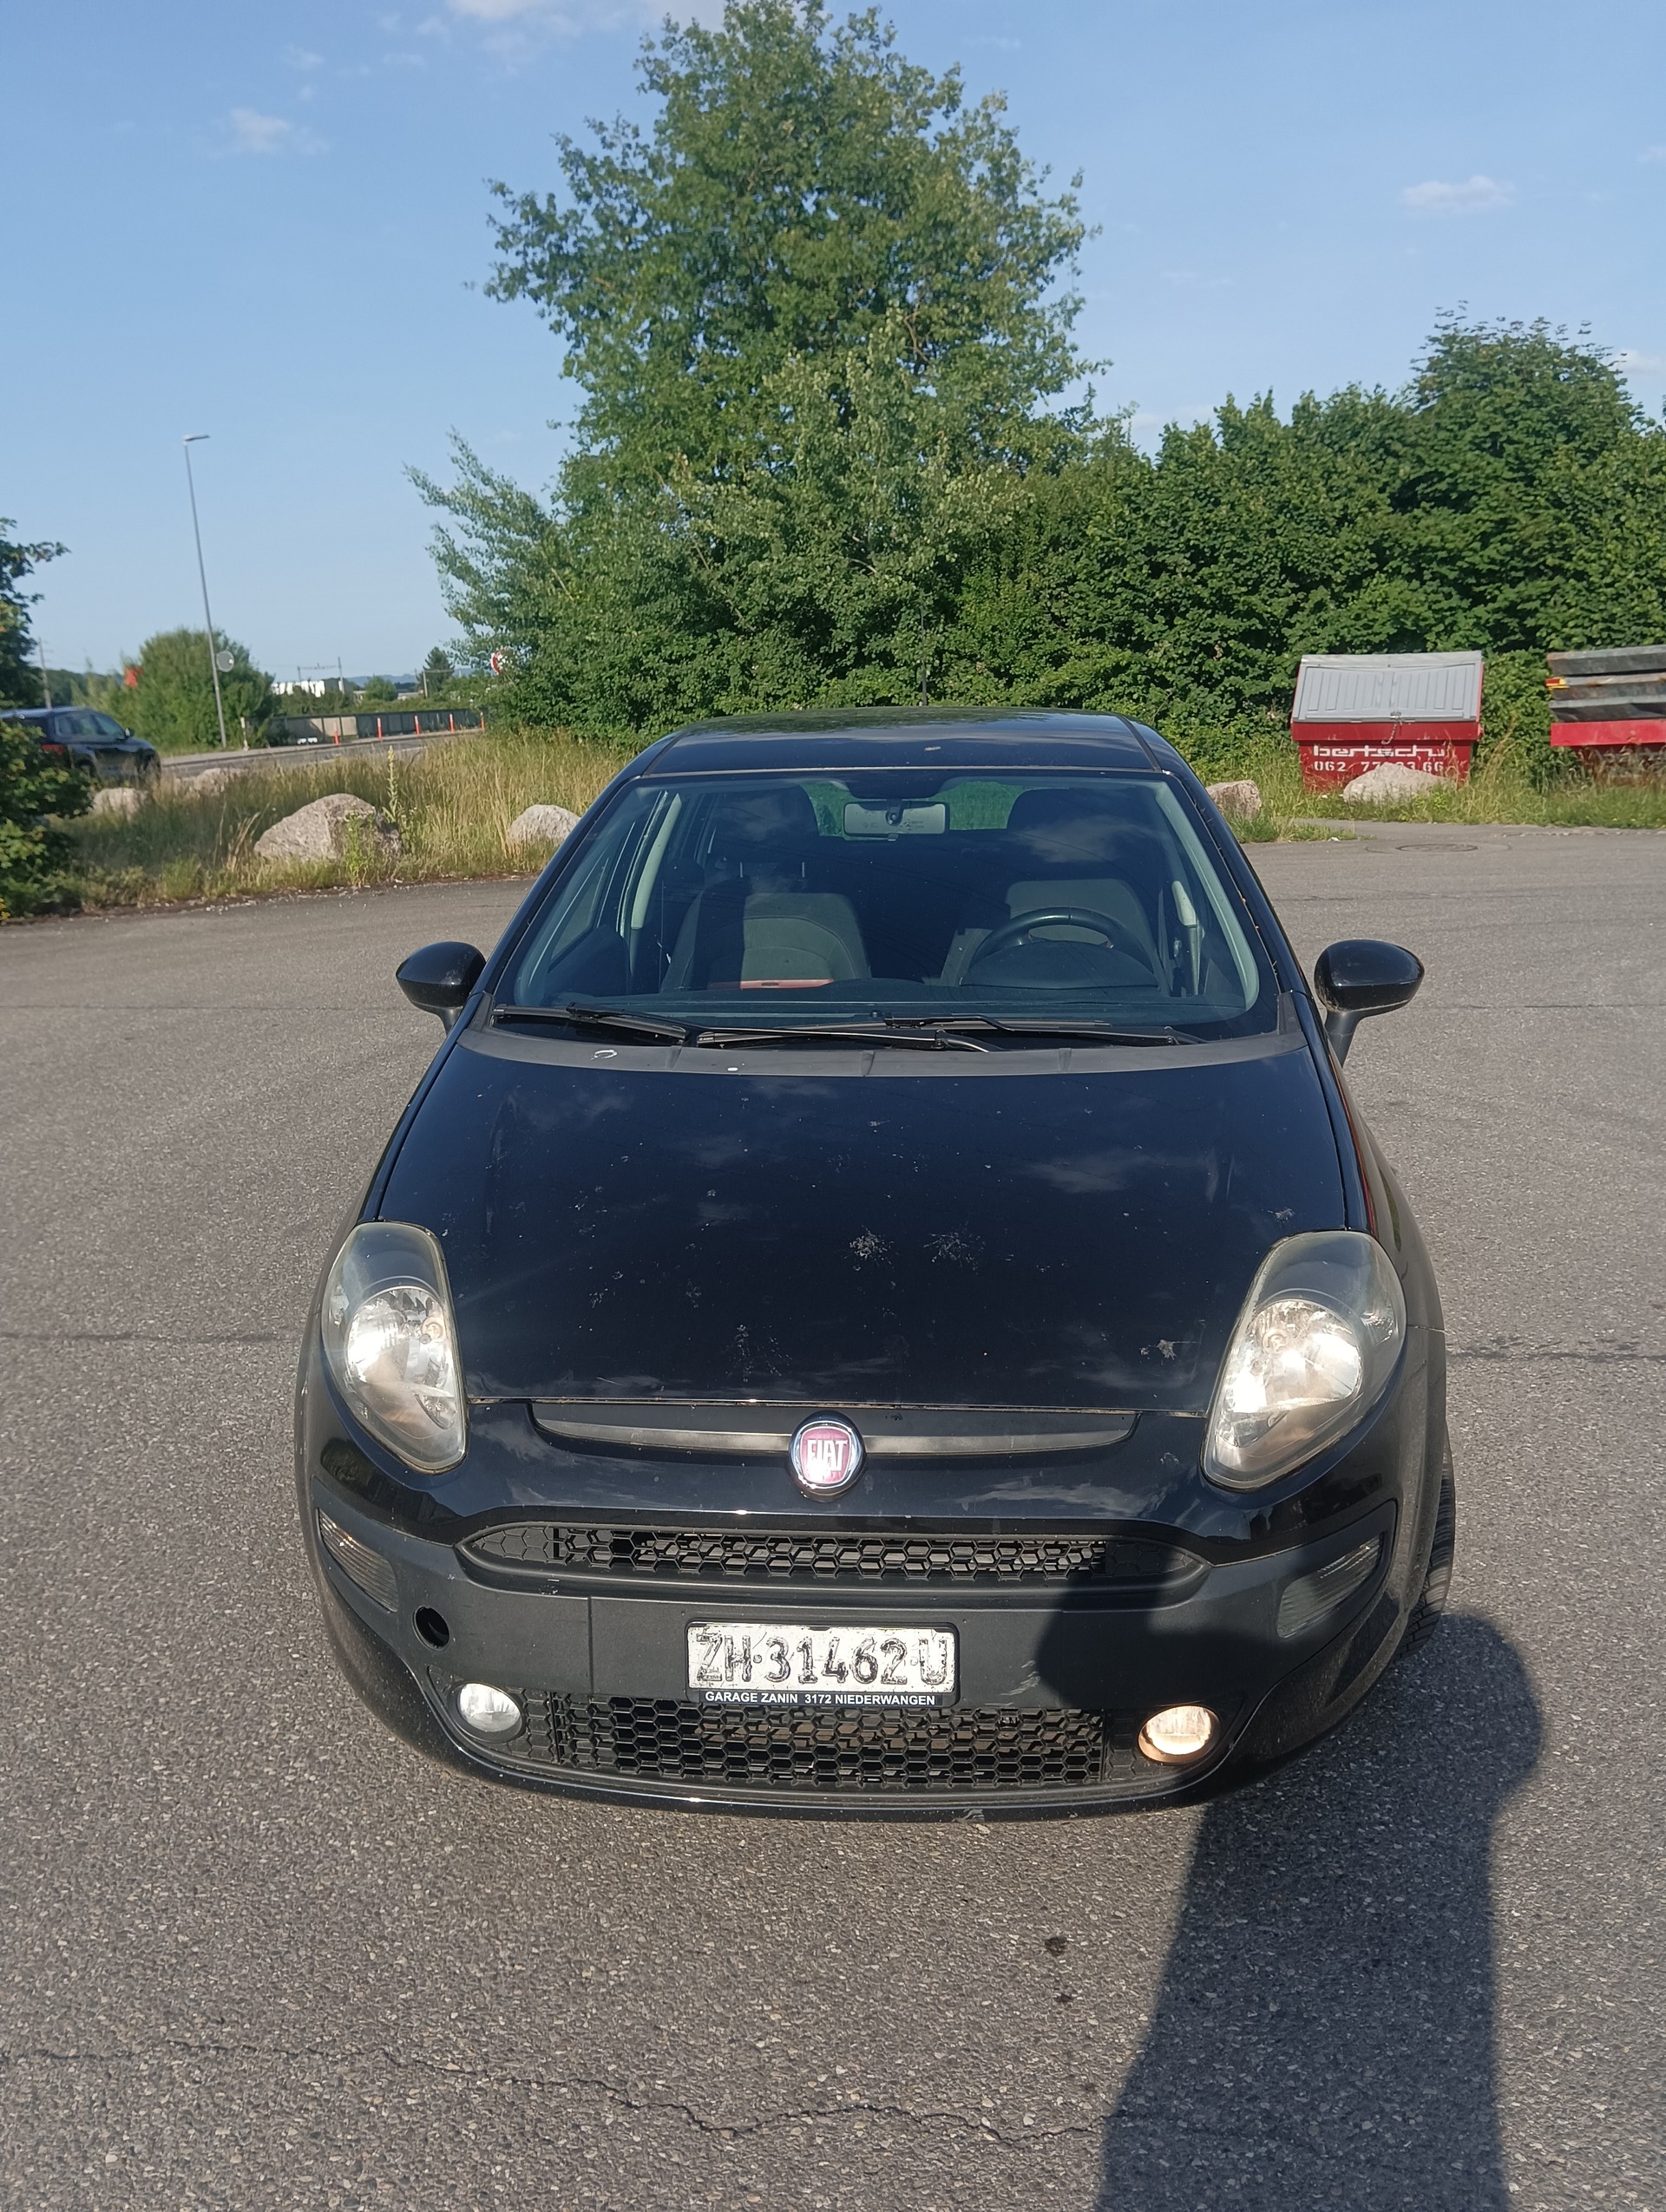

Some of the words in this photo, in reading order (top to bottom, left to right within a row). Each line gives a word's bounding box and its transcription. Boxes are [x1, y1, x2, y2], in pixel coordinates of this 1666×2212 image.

[1314, 761, 1347, 772] 062
[1361, 761, 1393, 772] 77
[806, 1439, 848, 1472] FIAT
[705, 1691, 758, 1703] GARAGE
[760, 1692, 798, 1704] ZANIN
[804, 1693, 832, 1705] 3172
[835, 1694, 935, 1705] NIEDERWANGEN
